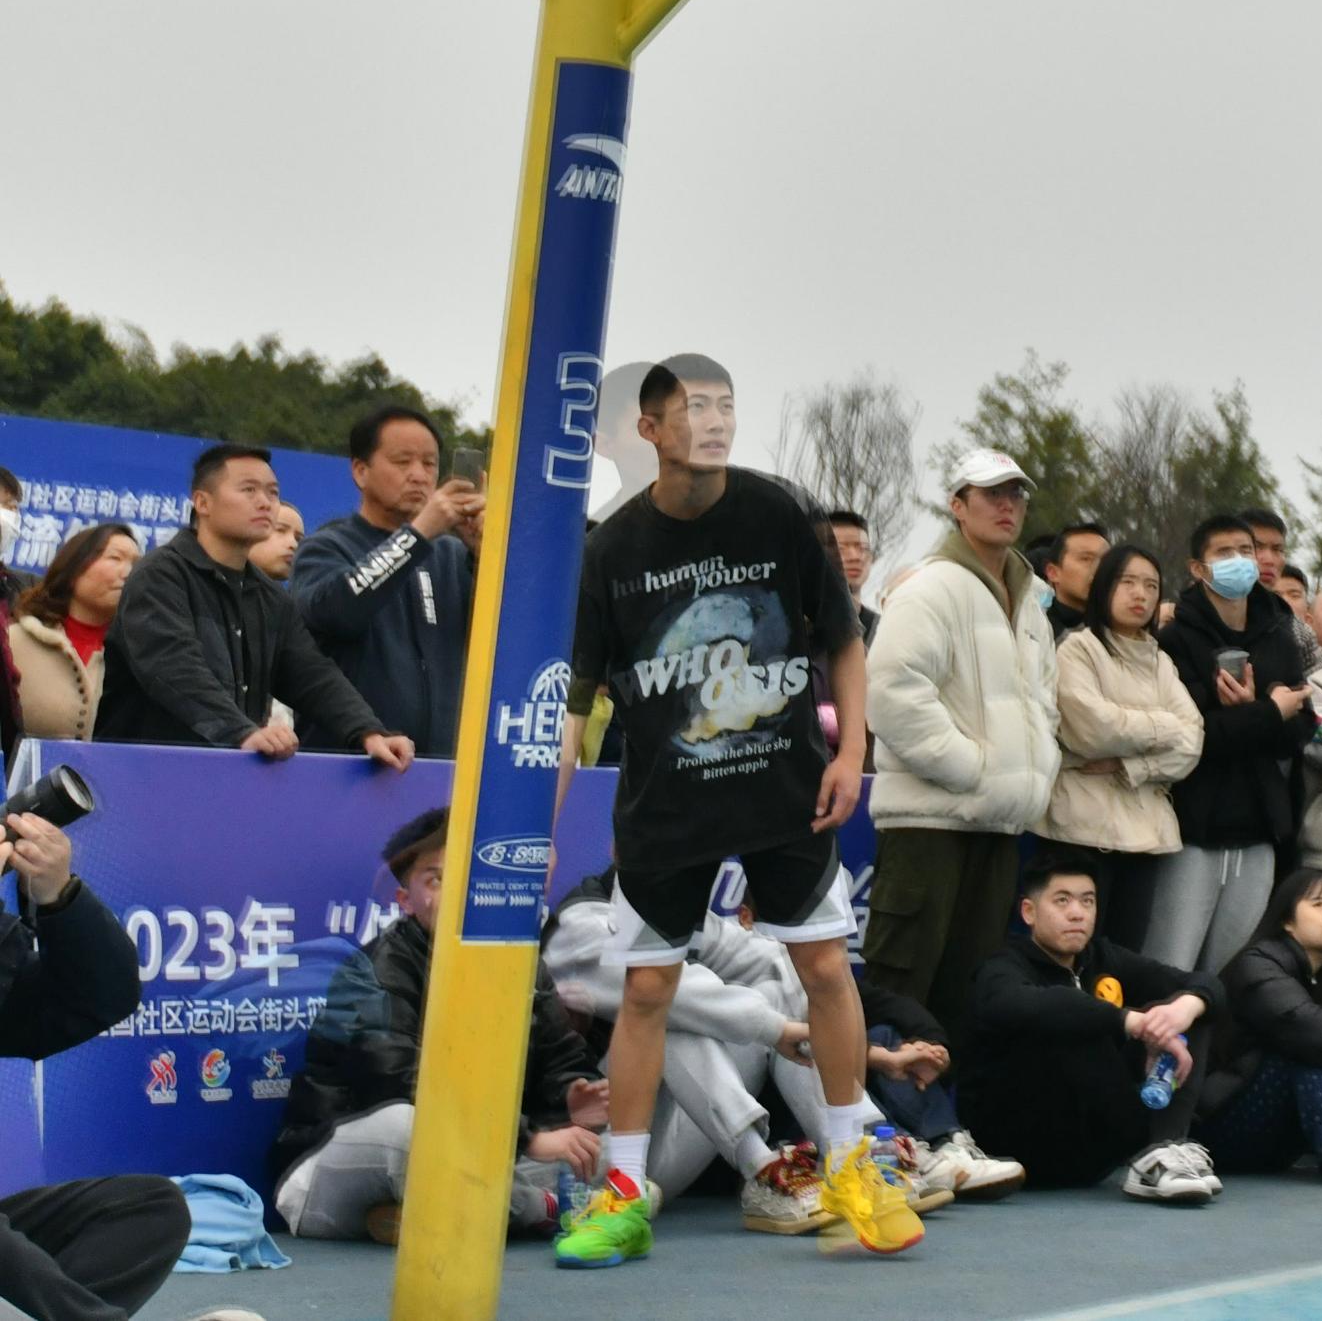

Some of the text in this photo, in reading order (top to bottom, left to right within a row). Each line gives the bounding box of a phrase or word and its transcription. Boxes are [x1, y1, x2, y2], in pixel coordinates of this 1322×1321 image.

[645, 555, 725, 593] human
[692, 561, 777, 599] power
[676, 736, 792, 769] Protect the blue sky
[702, 757, 769, 780] Bitten apple
[127, 900, 299, 986] 023年
